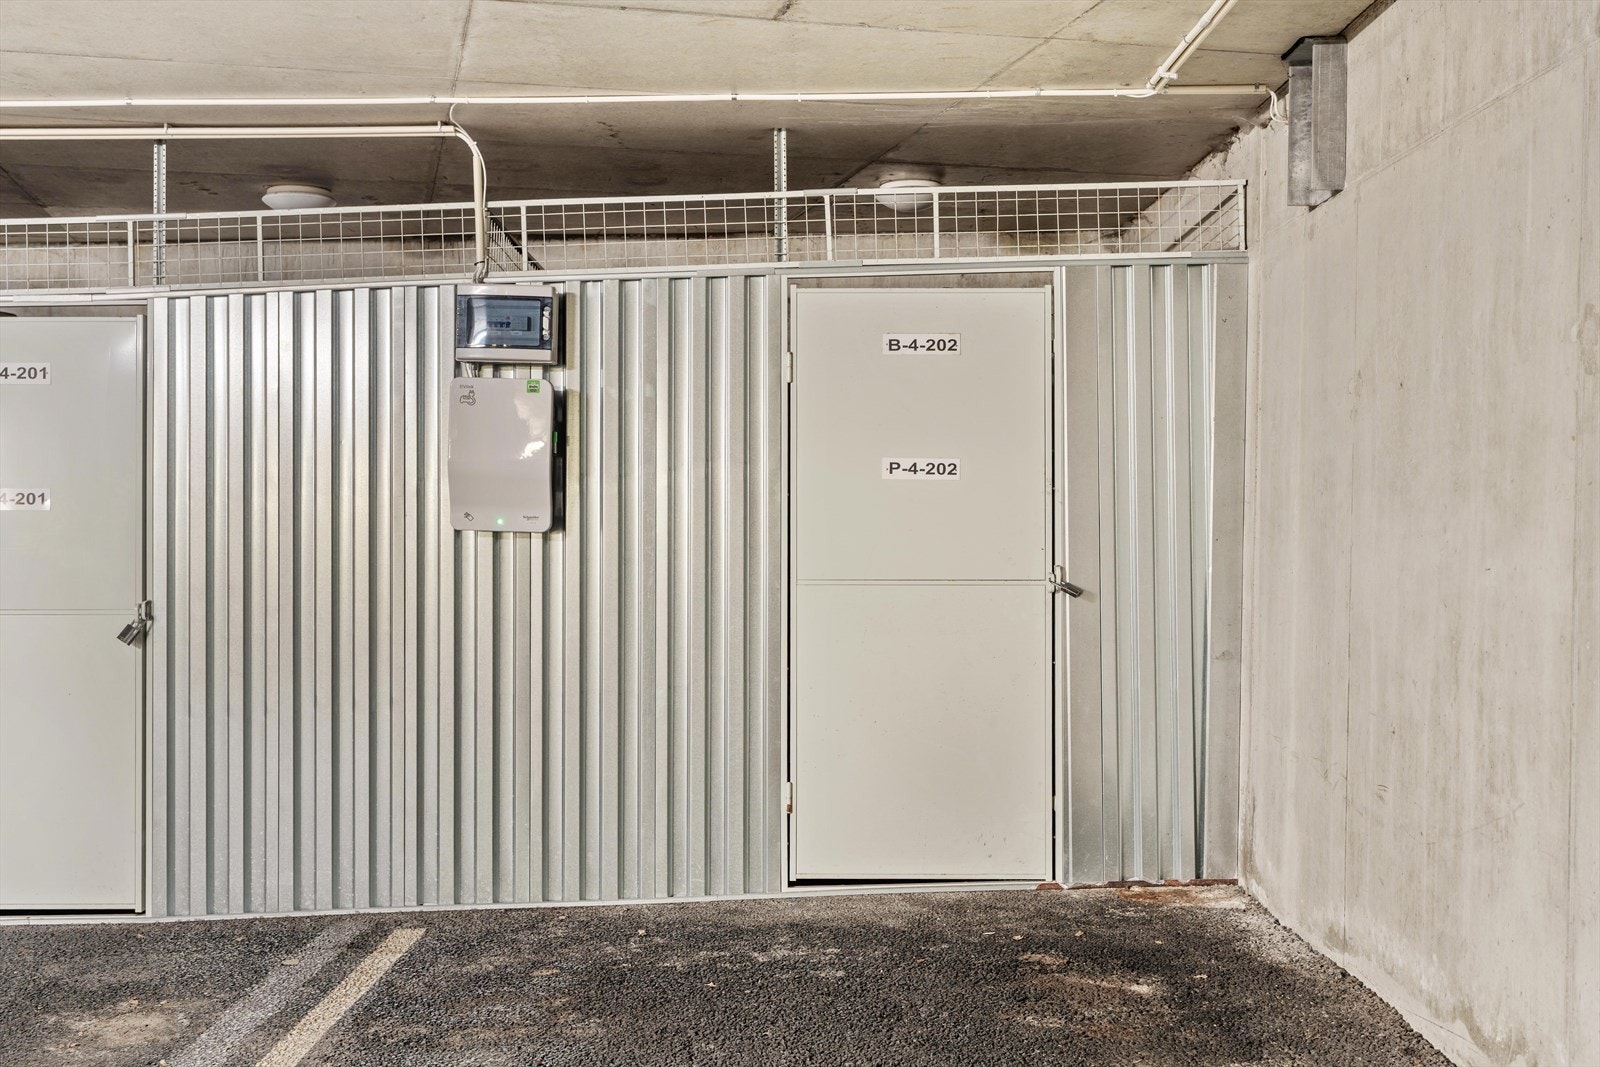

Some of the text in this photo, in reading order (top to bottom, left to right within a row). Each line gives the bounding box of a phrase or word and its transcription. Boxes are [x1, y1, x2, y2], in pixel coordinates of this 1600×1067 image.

[888, 339, 958, 351] B-4-202
[0, 367, 48, 379] 4-201
[889, 462, 957, 475] P-4-202
